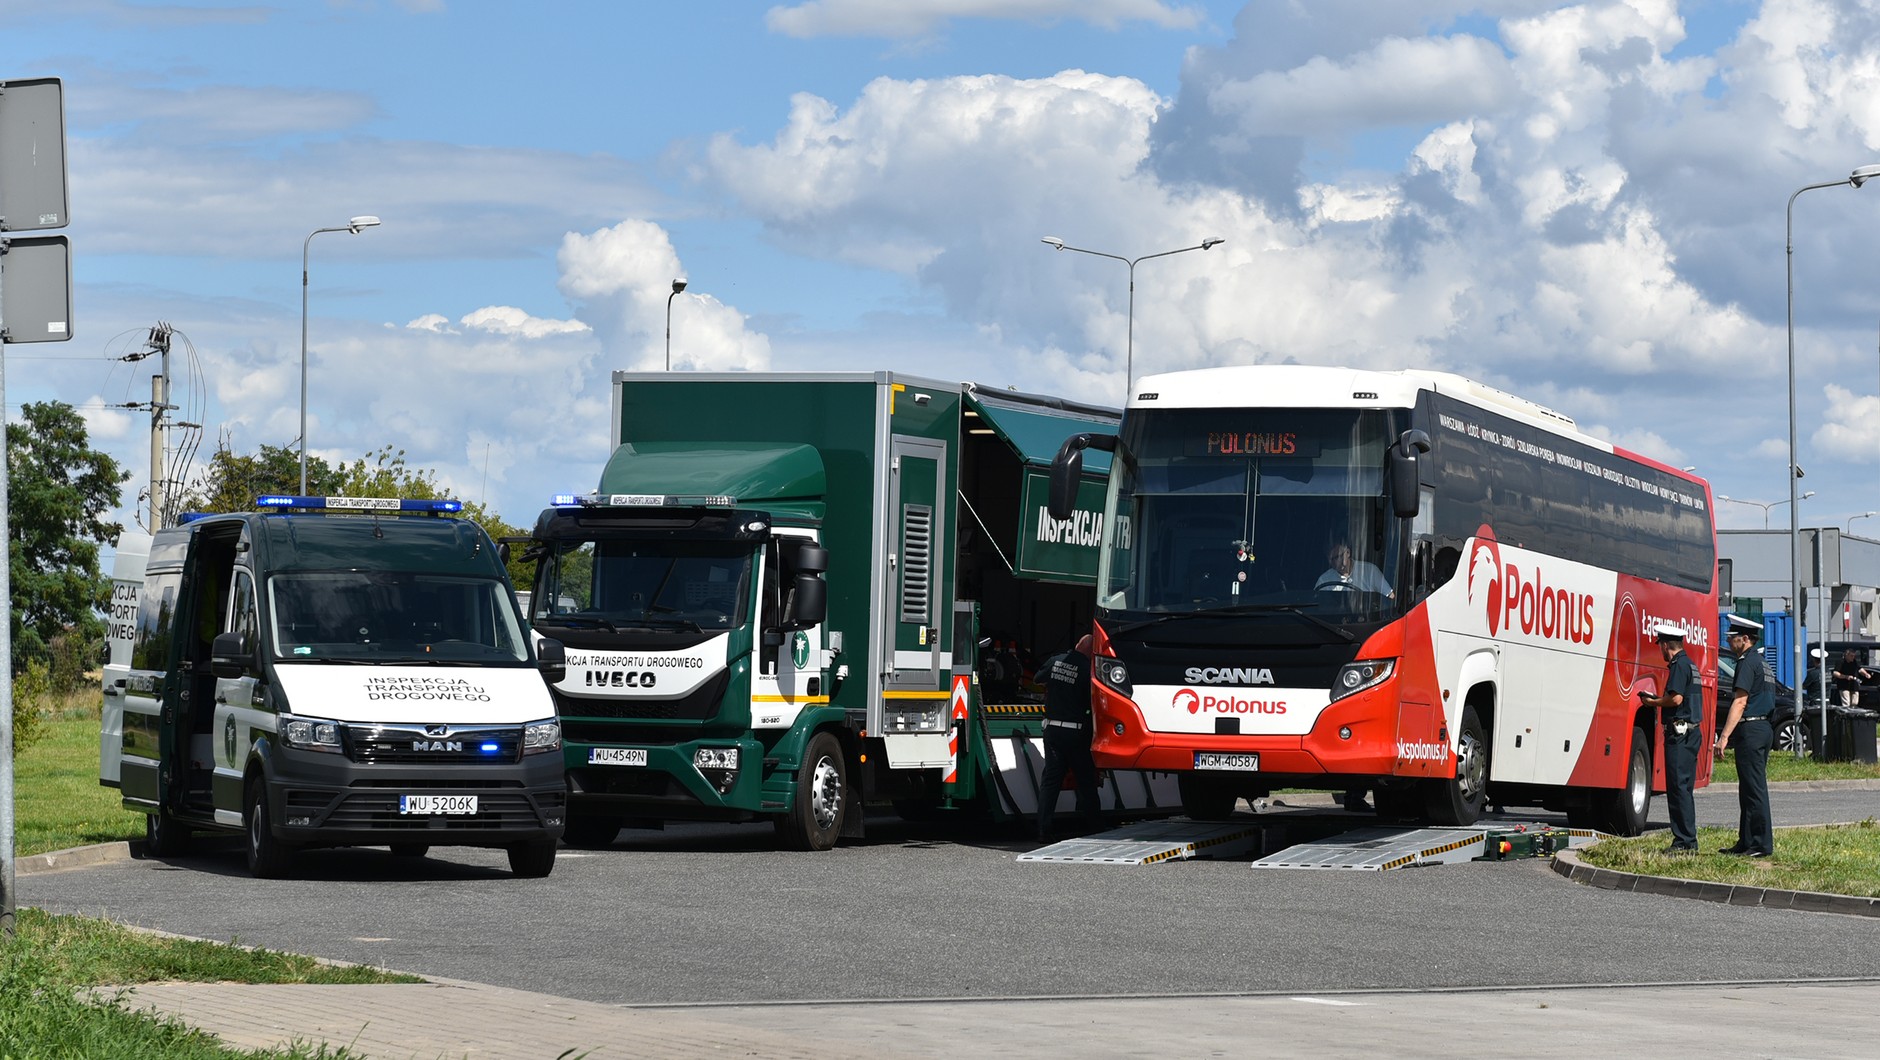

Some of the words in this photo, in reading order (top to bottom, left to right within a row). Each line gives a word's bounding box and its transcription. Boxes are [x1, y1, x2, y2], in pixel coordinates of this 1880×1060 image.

[1207, 432, 1296, 454] POLONUS
[1439, 413, 1466, 434] WARSZAWA
[1467, 422, 1480, 438] ŁÓDŹ
[1517, 439, 1540, 458] SZKLARSKA
[1539, 447, 1555, 464] PORĘBA
[1556, 452, 1582, 471] INOWROCŁAW
[1583, 461, 1602, 477] KOSZALIN
[1624, 475, 1640, 490] OLSZTYN
[1641, 480, 1659, 496] WROCŁAW
[1660, 487, 1670, 499] NOWY
[1669, 490, 1679, 504] SĄCZ
[1037, 505, 1104, 547] INSPEKCJA
[1116, 515, 1132, 550] TR
[1505, 563, 1594, 645] Polonus
[565, 655, 587, 666] KCJA
[590, 656, 645, 667] TRANSPORTU
[647, 657, 703, 669] DROGOWEGO
[368, 677, 469, 685] INSPEKCJA
[585, 670, 657, 688] IVECO
[1184, 667, 1275, 684] SCANIA
[363, 685, 485, 694] TRANSPORTU
[368, 692, 491, 702] DROGOWEGO
[1203, 696, 1287, 714] Polonus
[412, 741, 462, 752] MAN
[596, 749, 609, 761] WU
[612, 750, 645, 762] 4549N
[1200, 754, 1221, 767] WGM
[1224, 755, 1257, 767] 40587
[409, 797, 427, 811] WU
[432, 797, 474, 811] 5206K
